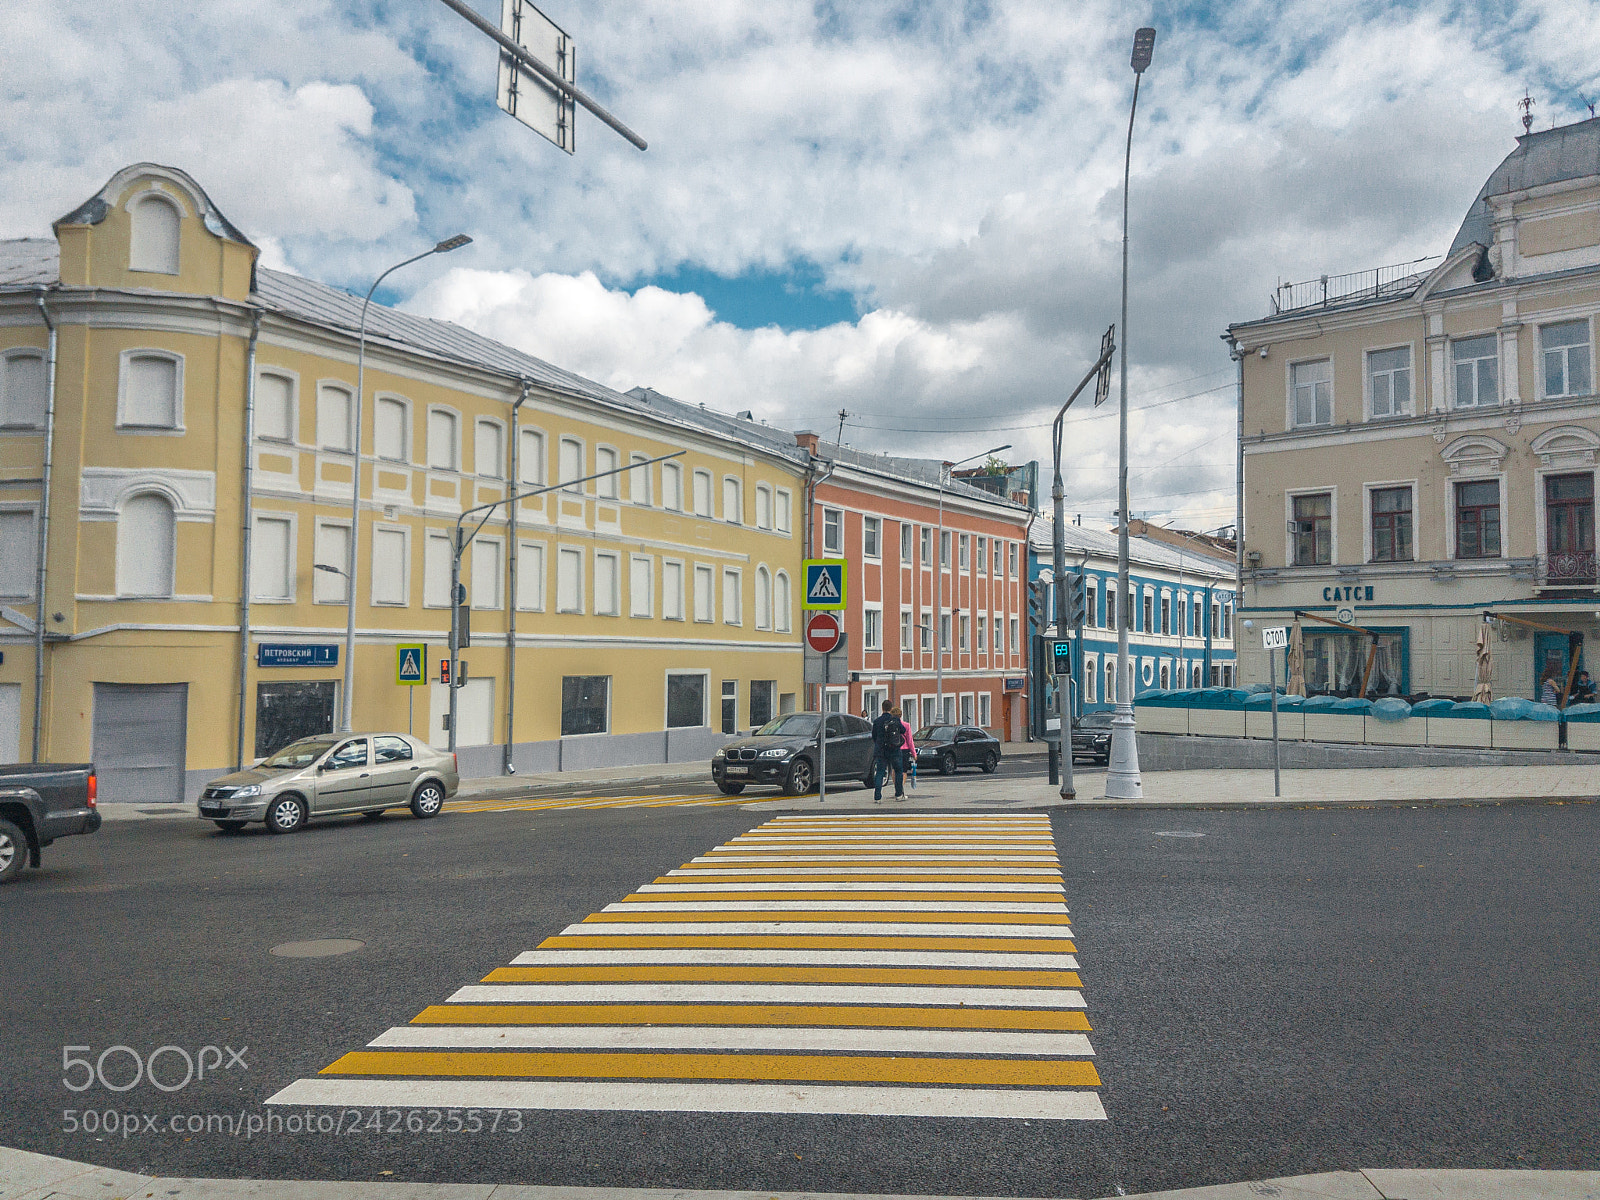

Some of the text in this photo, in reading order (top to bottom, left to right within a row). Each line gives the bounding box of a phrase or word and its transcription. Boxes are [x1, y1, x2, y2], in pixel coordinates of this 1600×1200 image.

[1323, 586, 1374, 601] CATCH
[1265, 630, 1285, 646] СТОП
[264, 648, 329, 659] ПЕТРОВСКИЙ 1
[1055, 644, 1068, 656] 69
